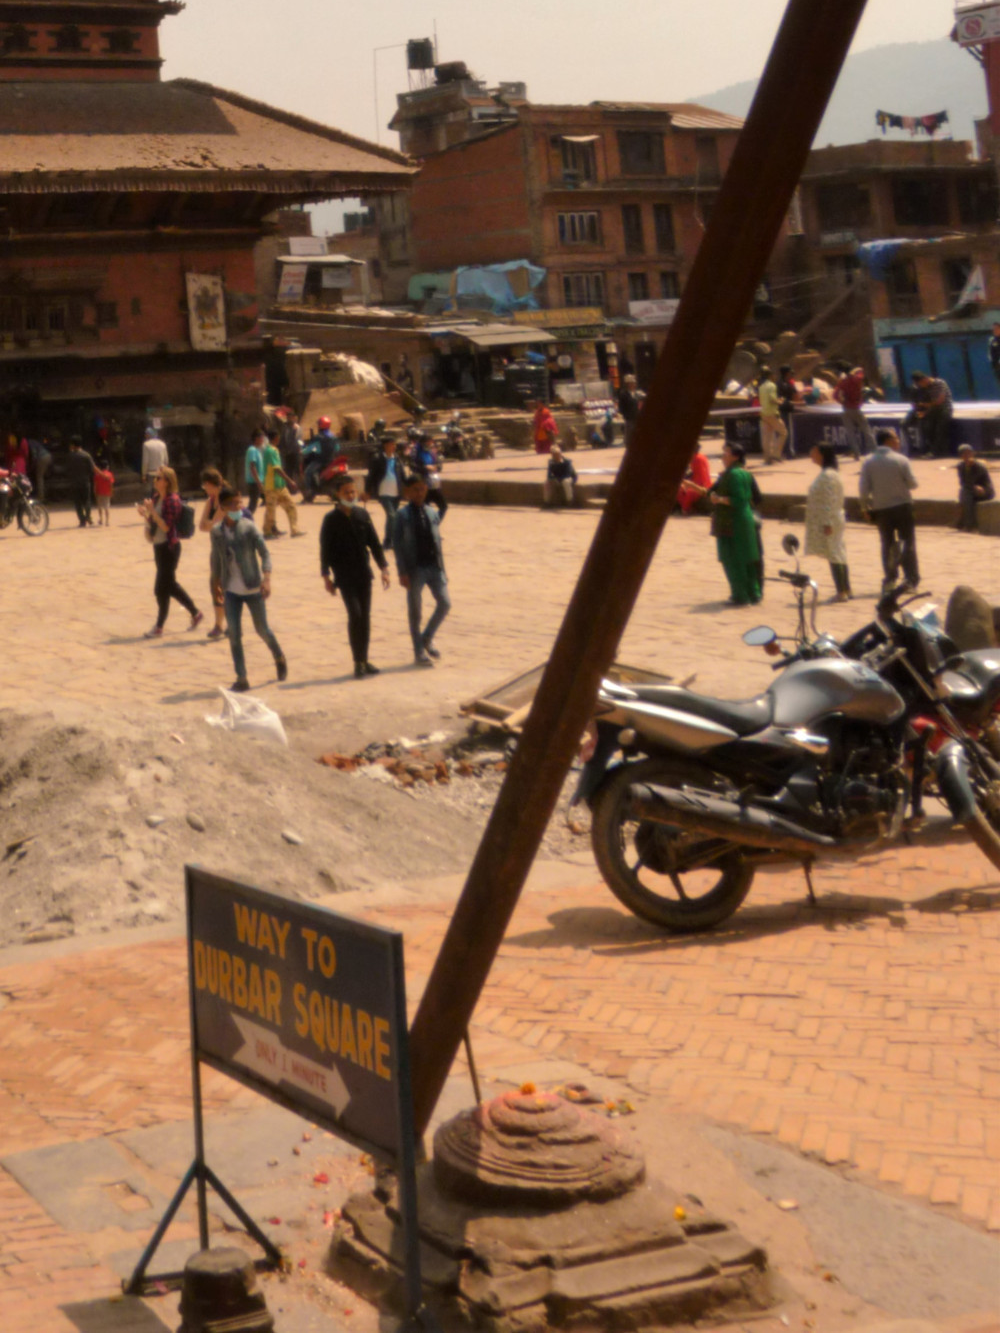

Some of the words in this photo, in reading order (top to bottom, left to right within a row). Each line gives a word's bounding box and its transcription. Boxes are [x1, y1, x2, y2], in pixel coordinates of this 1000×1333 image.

[234, 903, 291, 959] WAY
[302, 928, 336, 979] TO
[194, 940, 281, 1026] DURBAR
[294, 983, 391, 1081] SQUARE
[255, 1039, 277, 1064] ONLY
[291, 1059, 327, 1093] MINUTE
